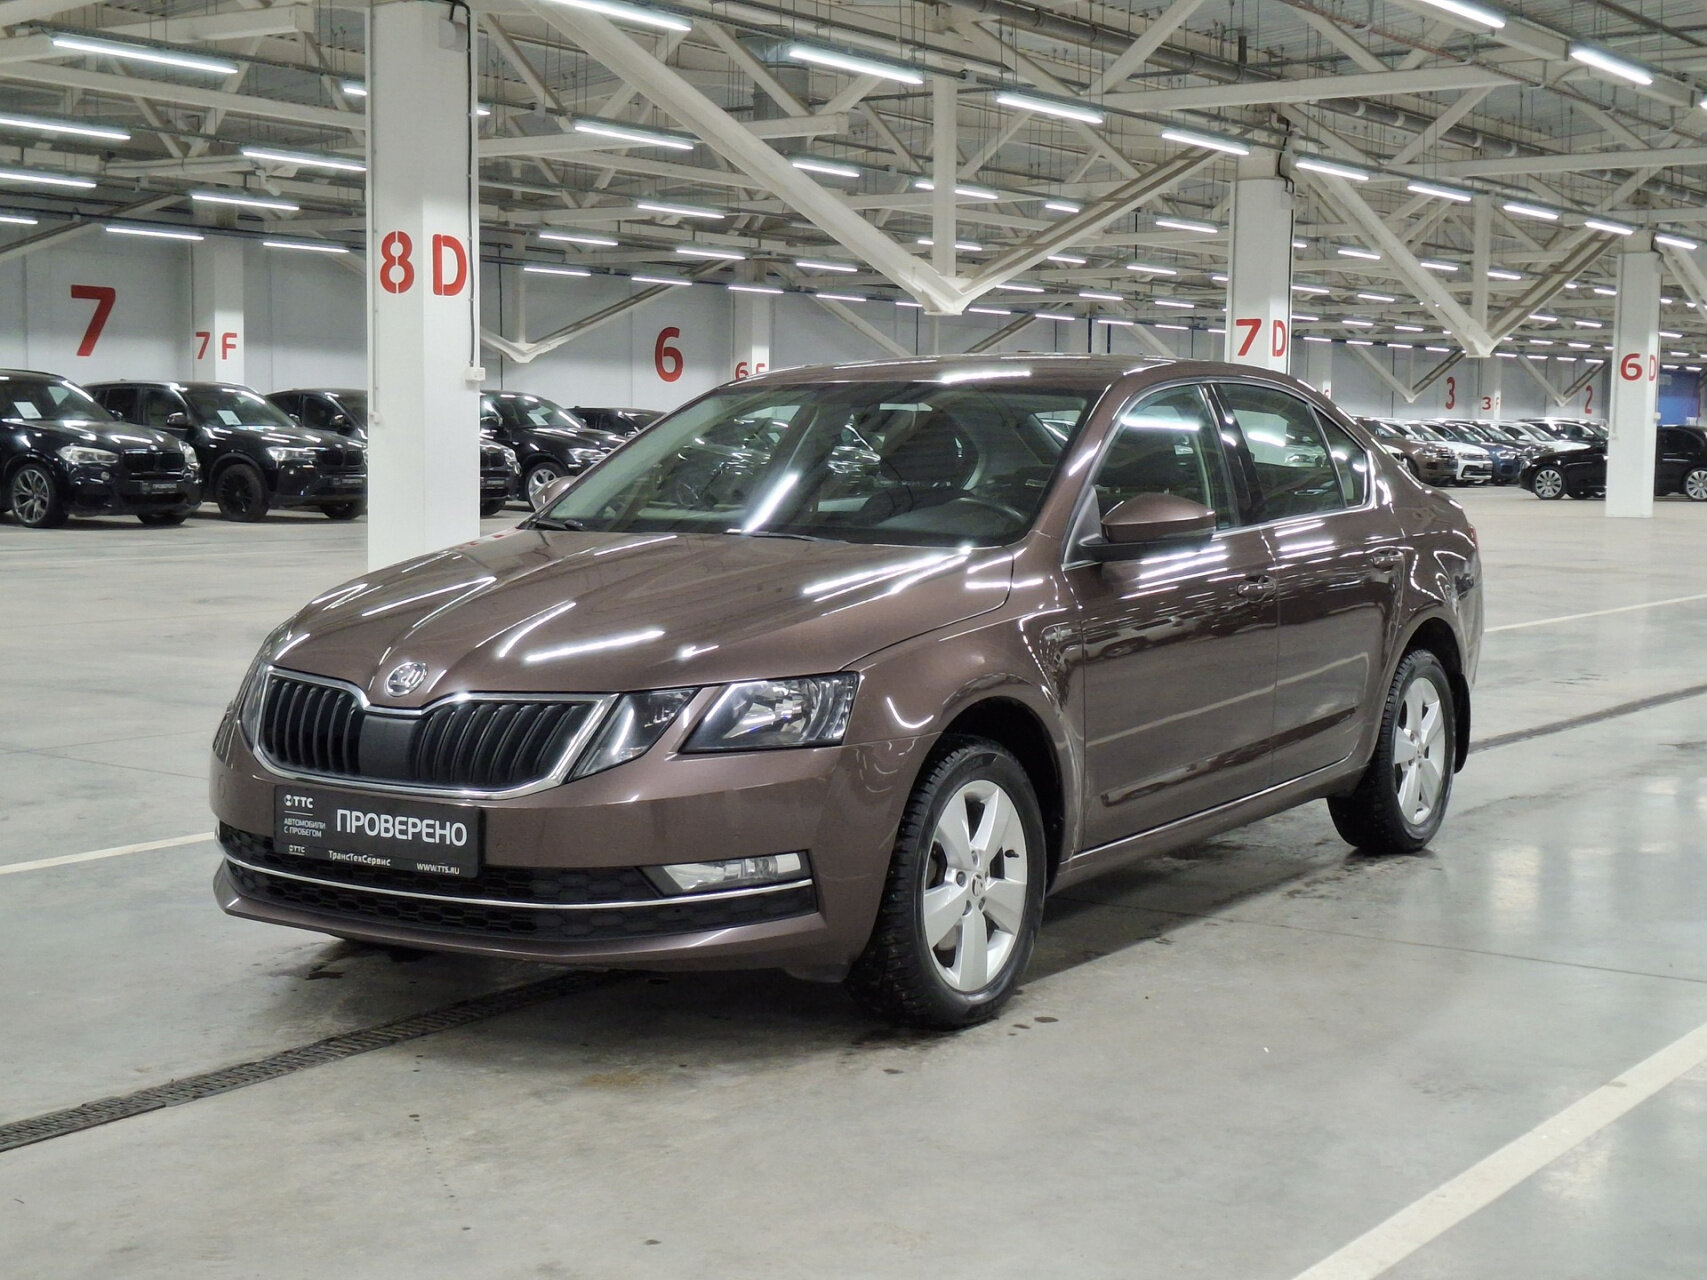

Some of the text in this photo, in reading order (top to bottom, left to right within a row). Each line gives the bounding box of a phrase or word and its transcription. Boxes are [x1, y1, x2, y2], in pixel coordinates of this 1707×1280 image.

[379, 232, 468, 297] 8 D
[72, 286, 116, 357] 7
[196, 331, 237, 359] 7 F
[1235, 318, 1287, 357] 7 D
[656, 327, 684, 384] 6
[1620, 352, 1657, 382] 6 D
[1445, 376, 1456, 410] 3
[1481, 396, 1492, 411] 3
[1584, 384, 1593, 414] 2
[284, 817, 326, 830] АВТОМОБИЛИ
[289, 826, 323, 838] ПРОБЕГОМ
[336, 808, 468, 848] ПРОВЕРЕНО
[328, 850, 392, 867] ТрансТехСервис
